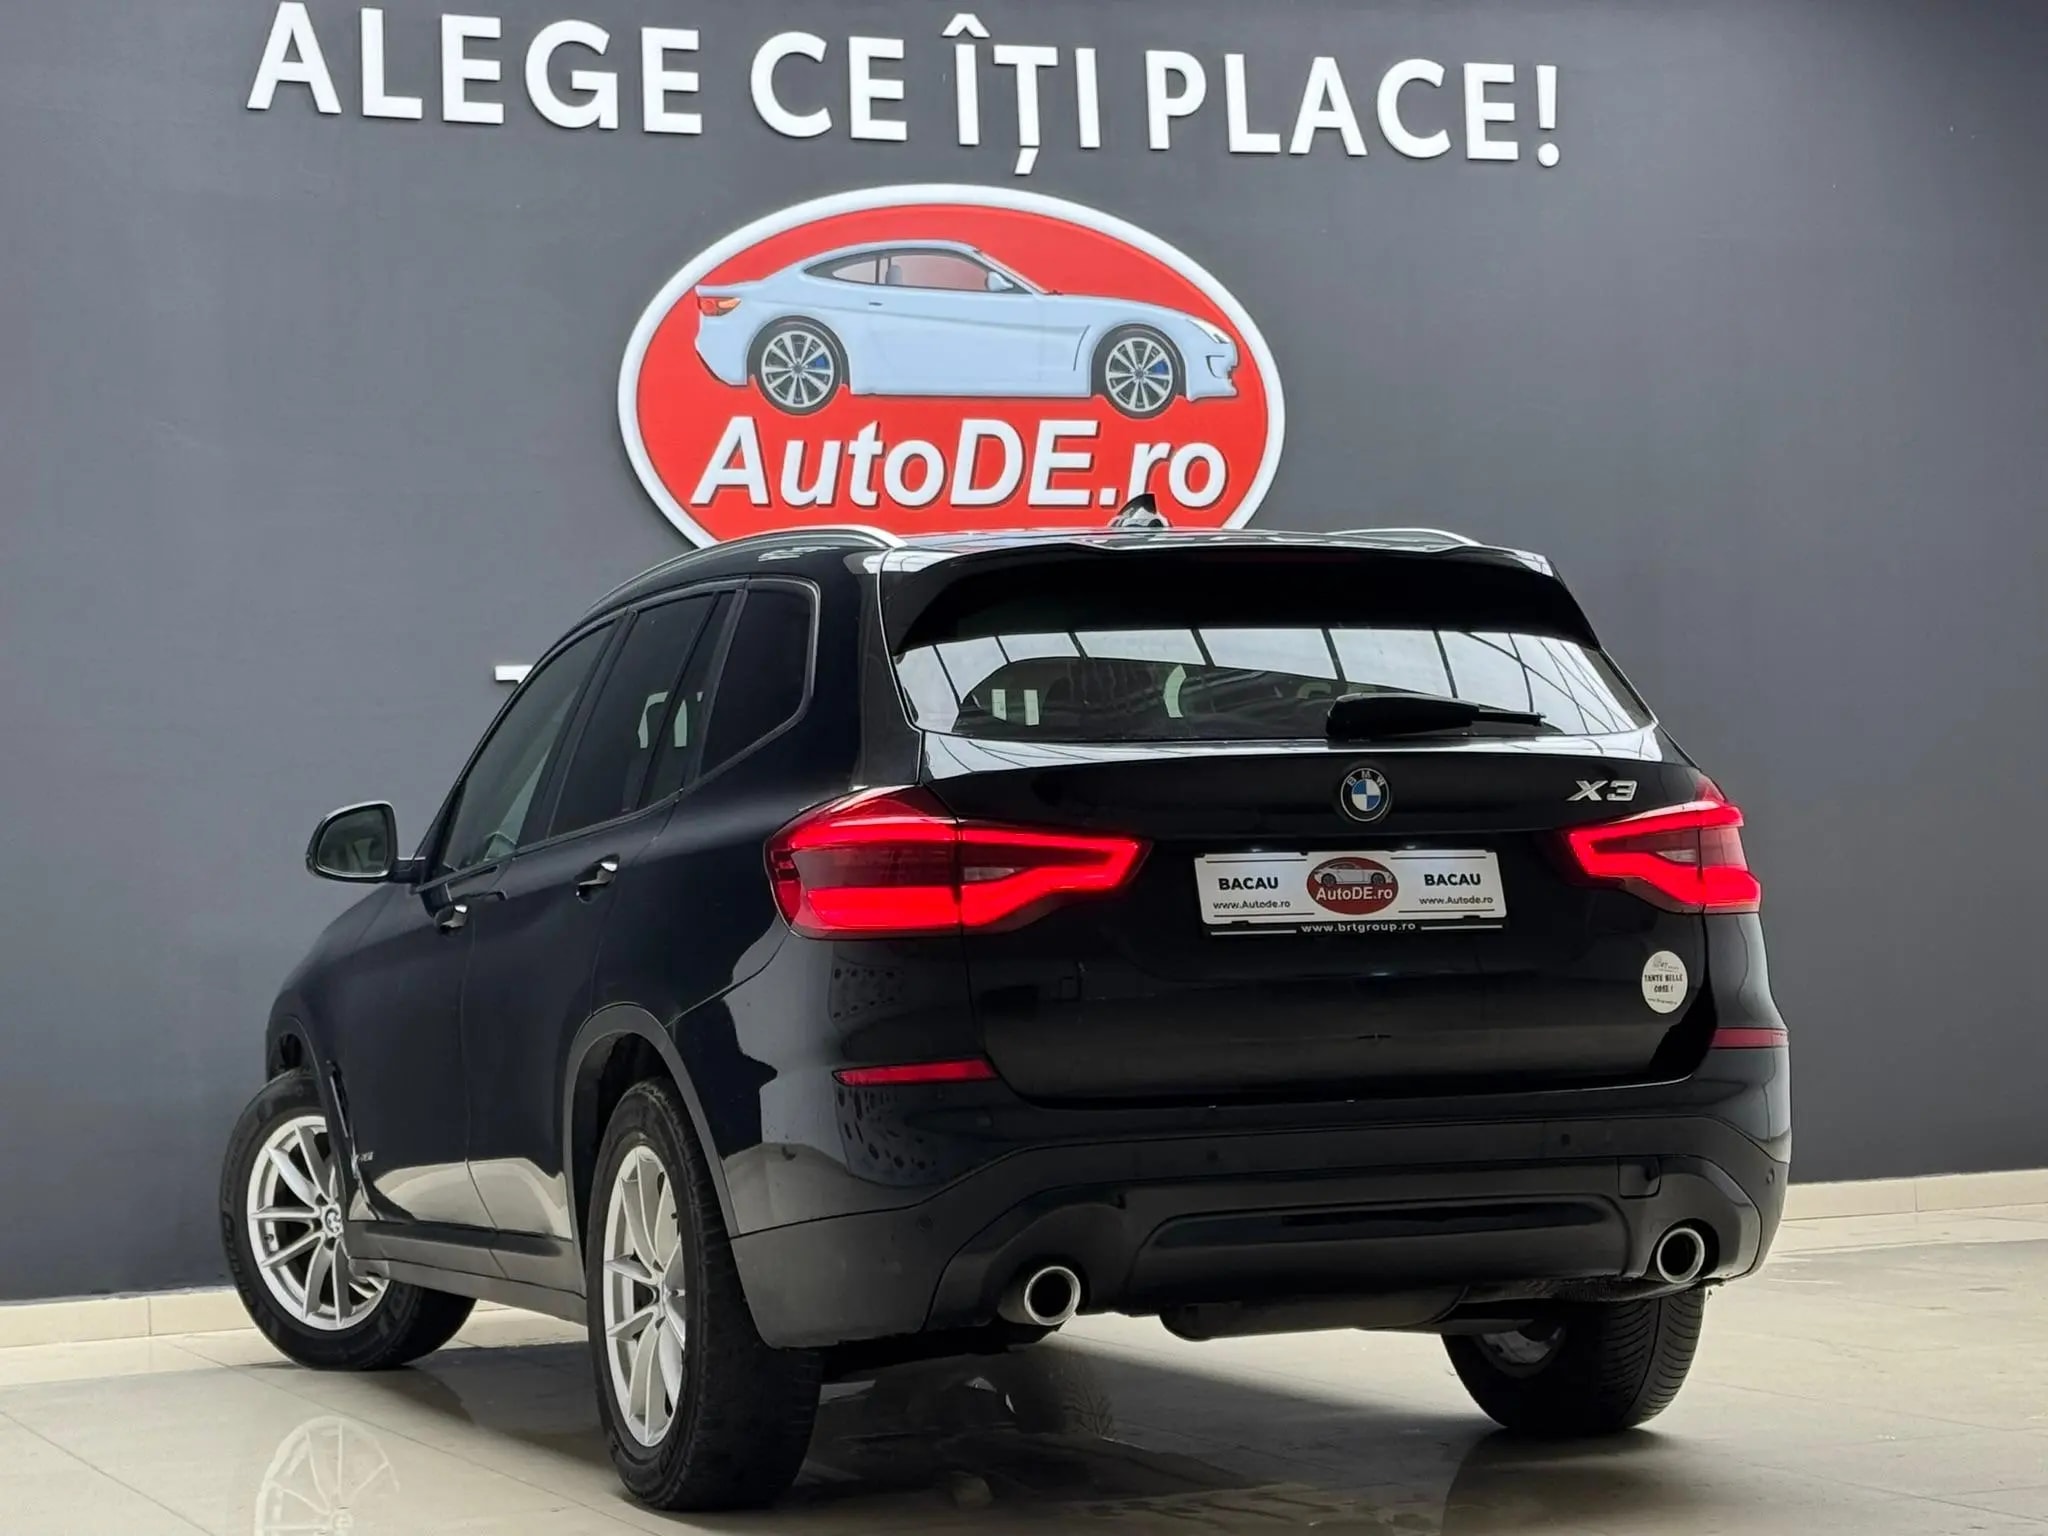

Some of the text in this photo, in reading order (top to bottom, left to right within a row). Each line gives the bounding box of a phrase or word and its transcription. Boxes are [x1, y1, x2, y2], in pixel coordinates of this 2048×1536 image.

[246, 1, 703, 134] ALEGE
[750, 31, 908, 141] CE
[1145, 50, 1561, 167] PLACE!
[691, 416, 1227, 508] AutoDE.ro
[1347, 770, 1385, 787] BMW
[1565, 780, 1637, 801] X3
[1218, 877, 1279, 891] BACAU
[1424, 873, 1481, 887] BACAU
[1315, 886, 1393, 901] AutoDE.ro
[1419, 896, 1494, 905] www.Autode.ro
[1213, 900, 1291, 909] www.Autode.ro
[1301, 922, 1416, 933] www.brtgroup.ro
